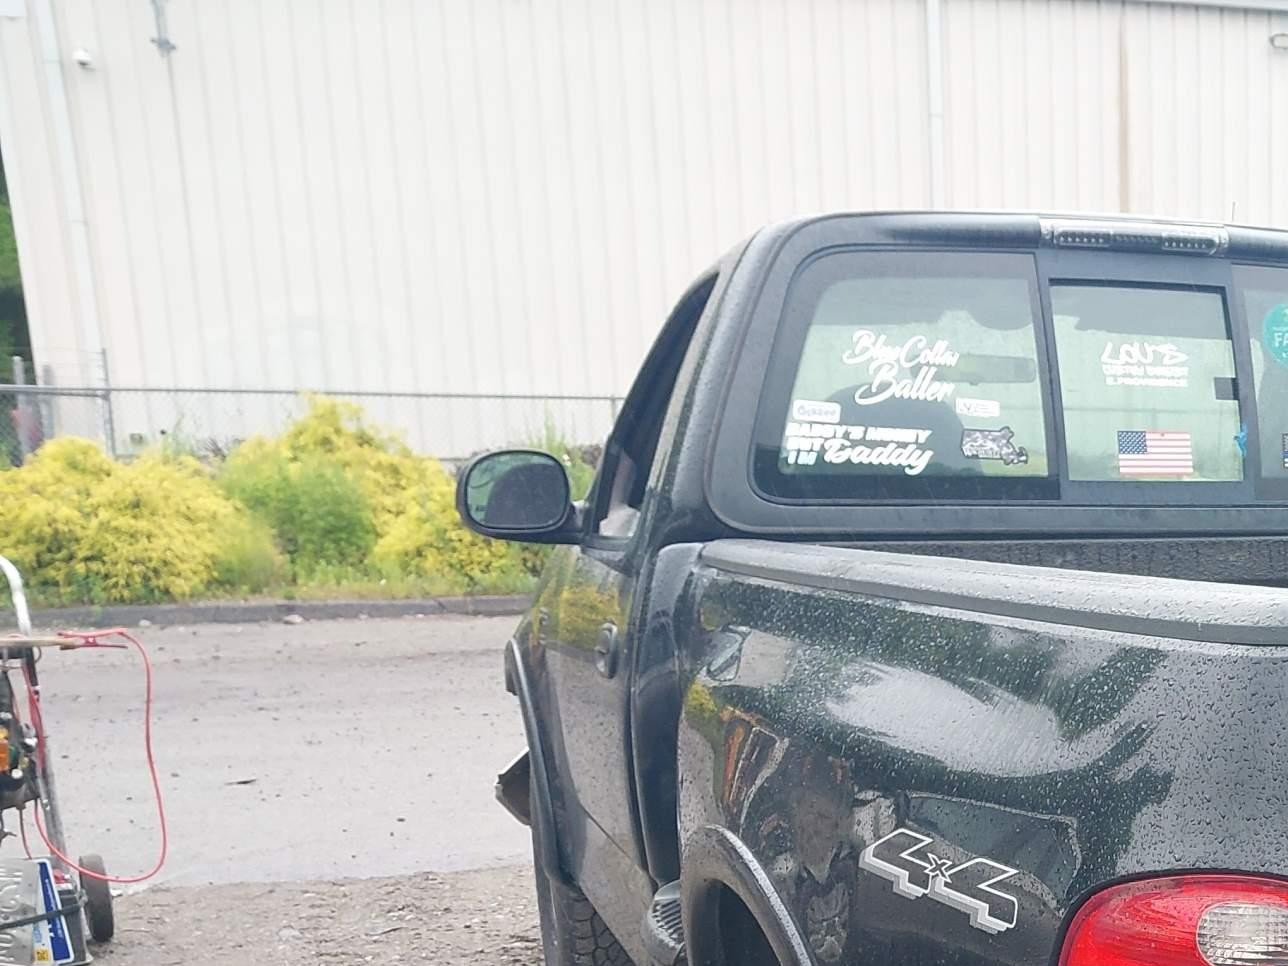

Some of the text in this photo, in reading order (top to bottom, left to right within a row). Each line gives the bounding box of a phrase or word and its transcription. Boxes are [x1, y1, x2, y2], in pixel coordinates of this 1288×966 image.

[842, 329, 960, 368] Blue Collar
[854, 359, 956, 406] Baller
